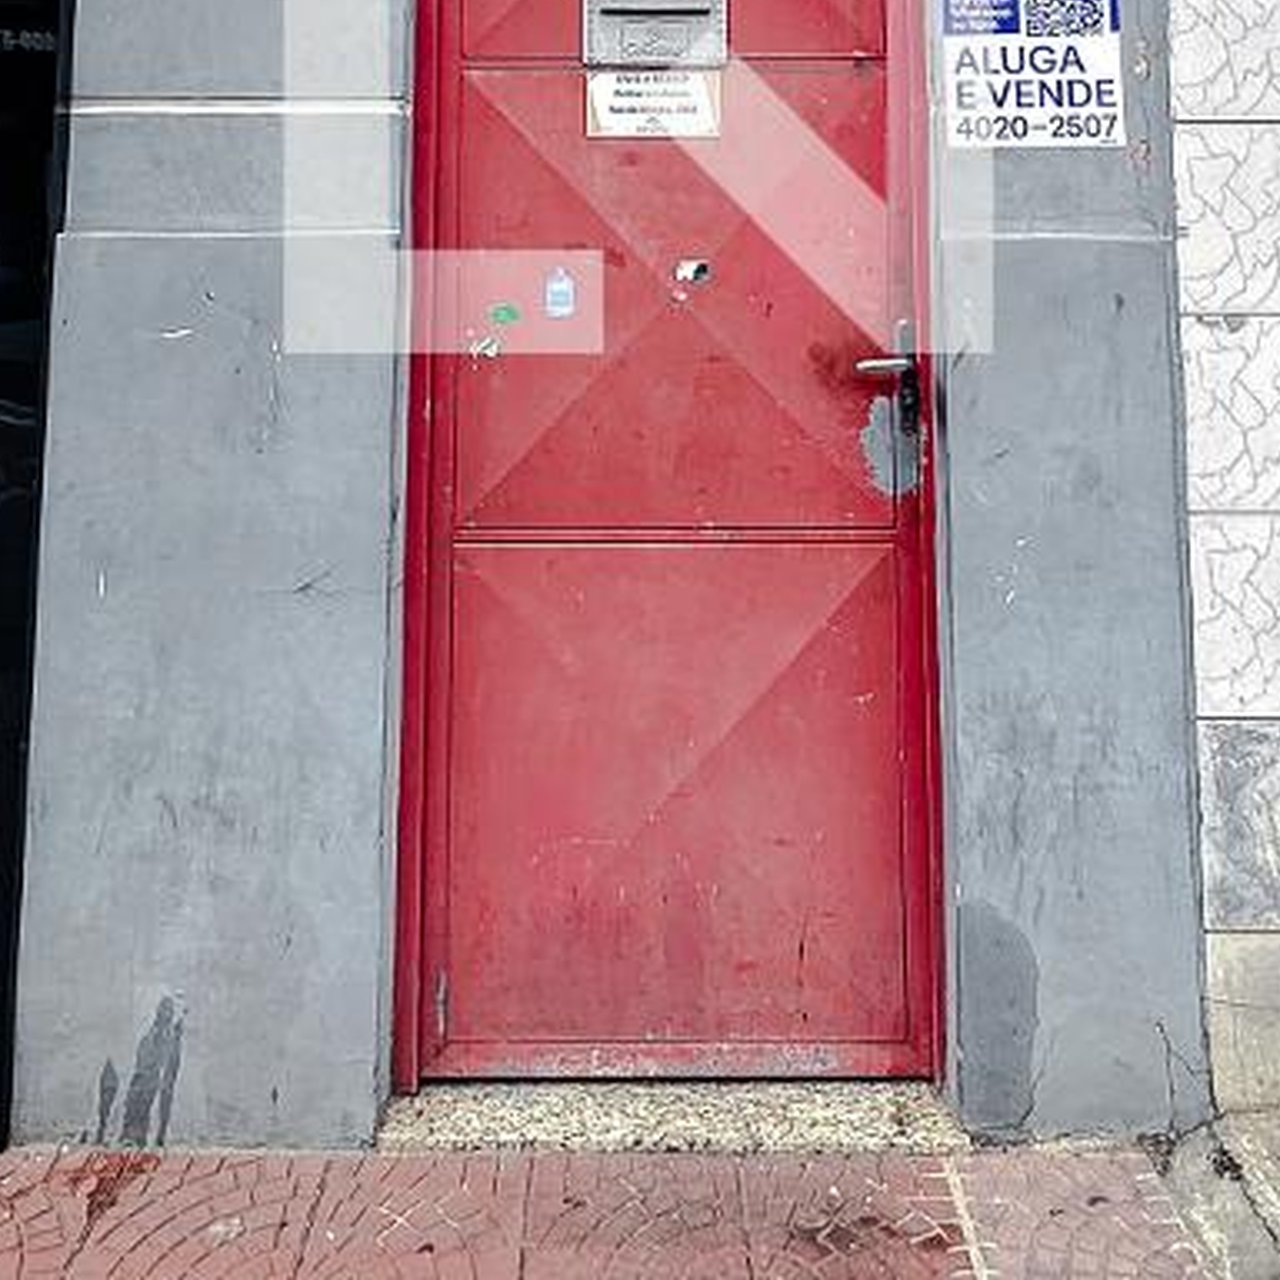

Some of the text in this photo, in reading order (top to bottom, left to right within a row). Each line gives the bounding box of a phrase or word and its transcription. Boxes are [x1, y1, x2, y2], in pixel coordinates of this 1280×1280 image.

[956, 45, 1086, 75] ALUGA
[956, 78, 1118, 110] E VENDE
[955, 112, 1118, 140] 4020-2507
